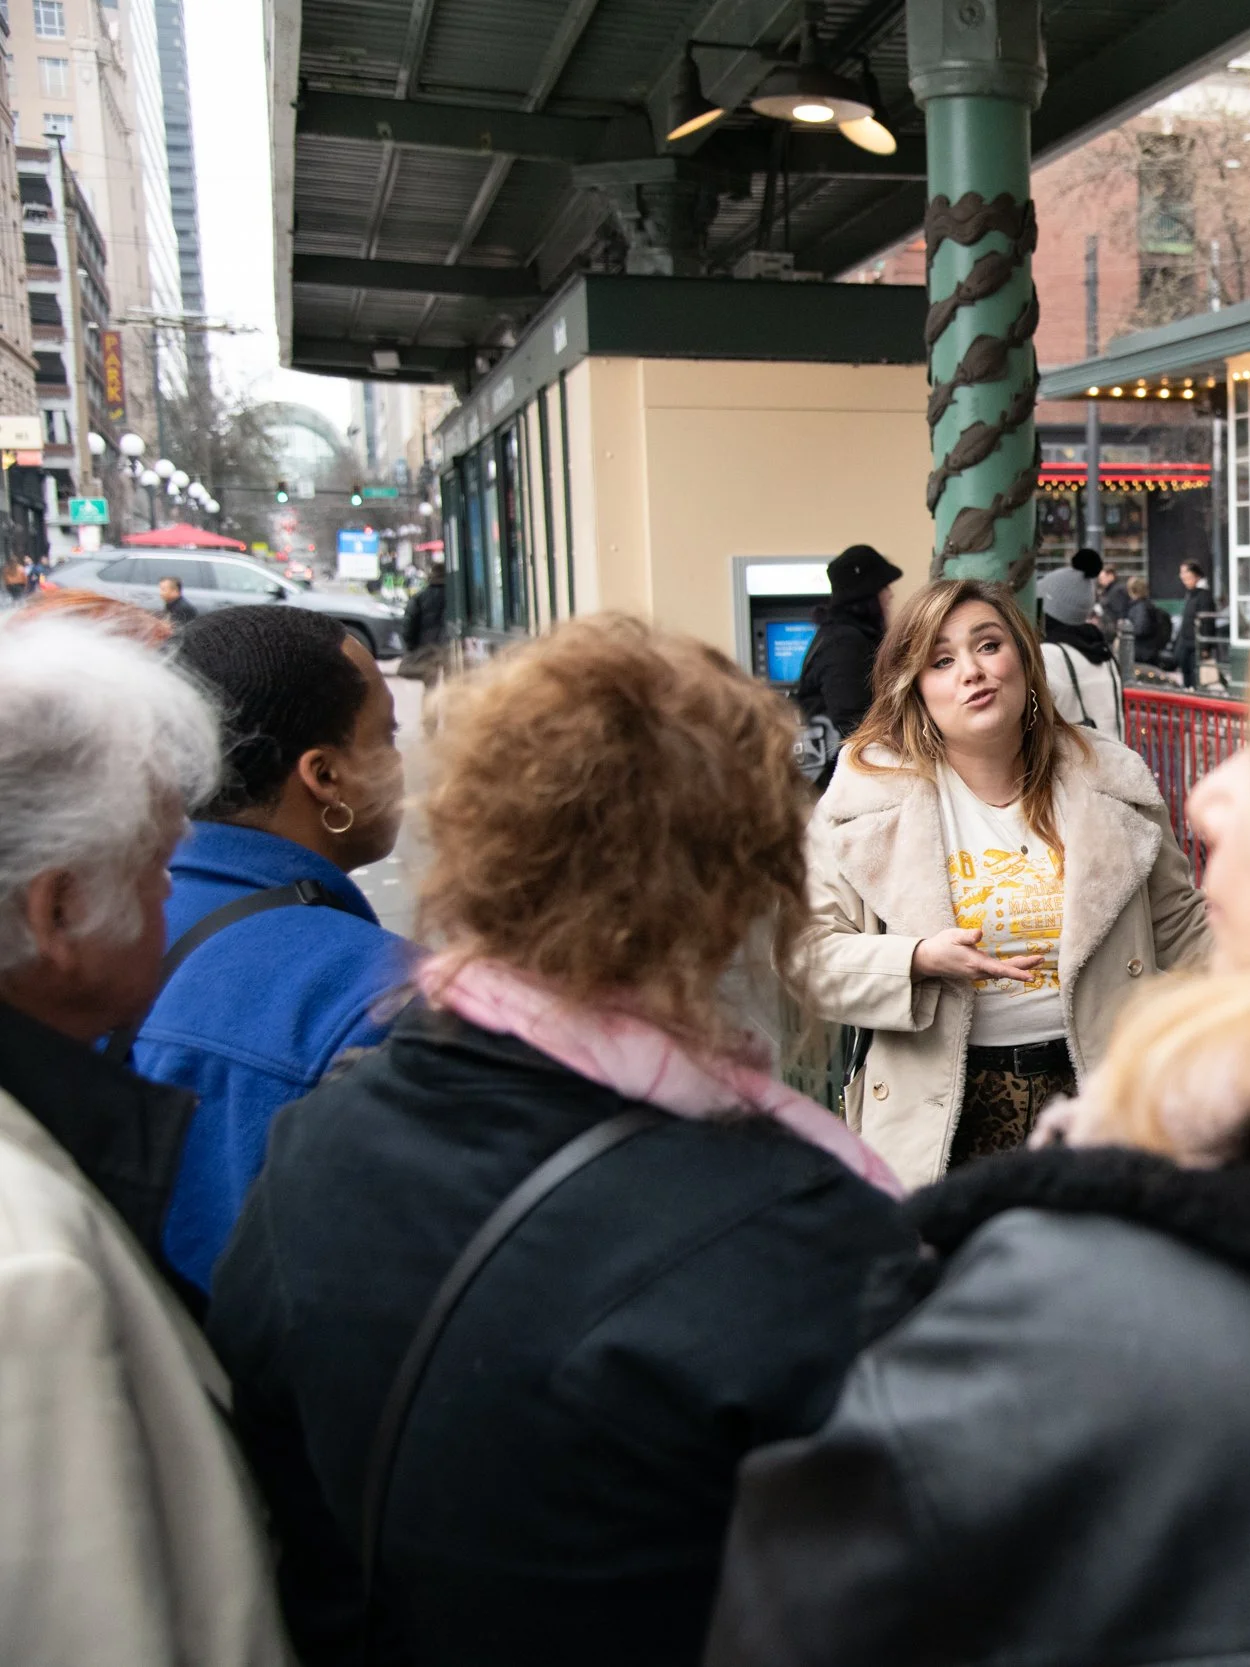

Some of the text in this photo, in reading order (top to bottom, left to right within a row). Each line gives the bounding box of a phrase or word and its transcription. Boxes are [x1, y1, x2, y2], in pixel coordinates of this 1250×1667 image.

[104, 333, 122, 402] PARK
[1008, 896, 1064, 915] MARKE
[1021, 912, 1064, 928] CENT
